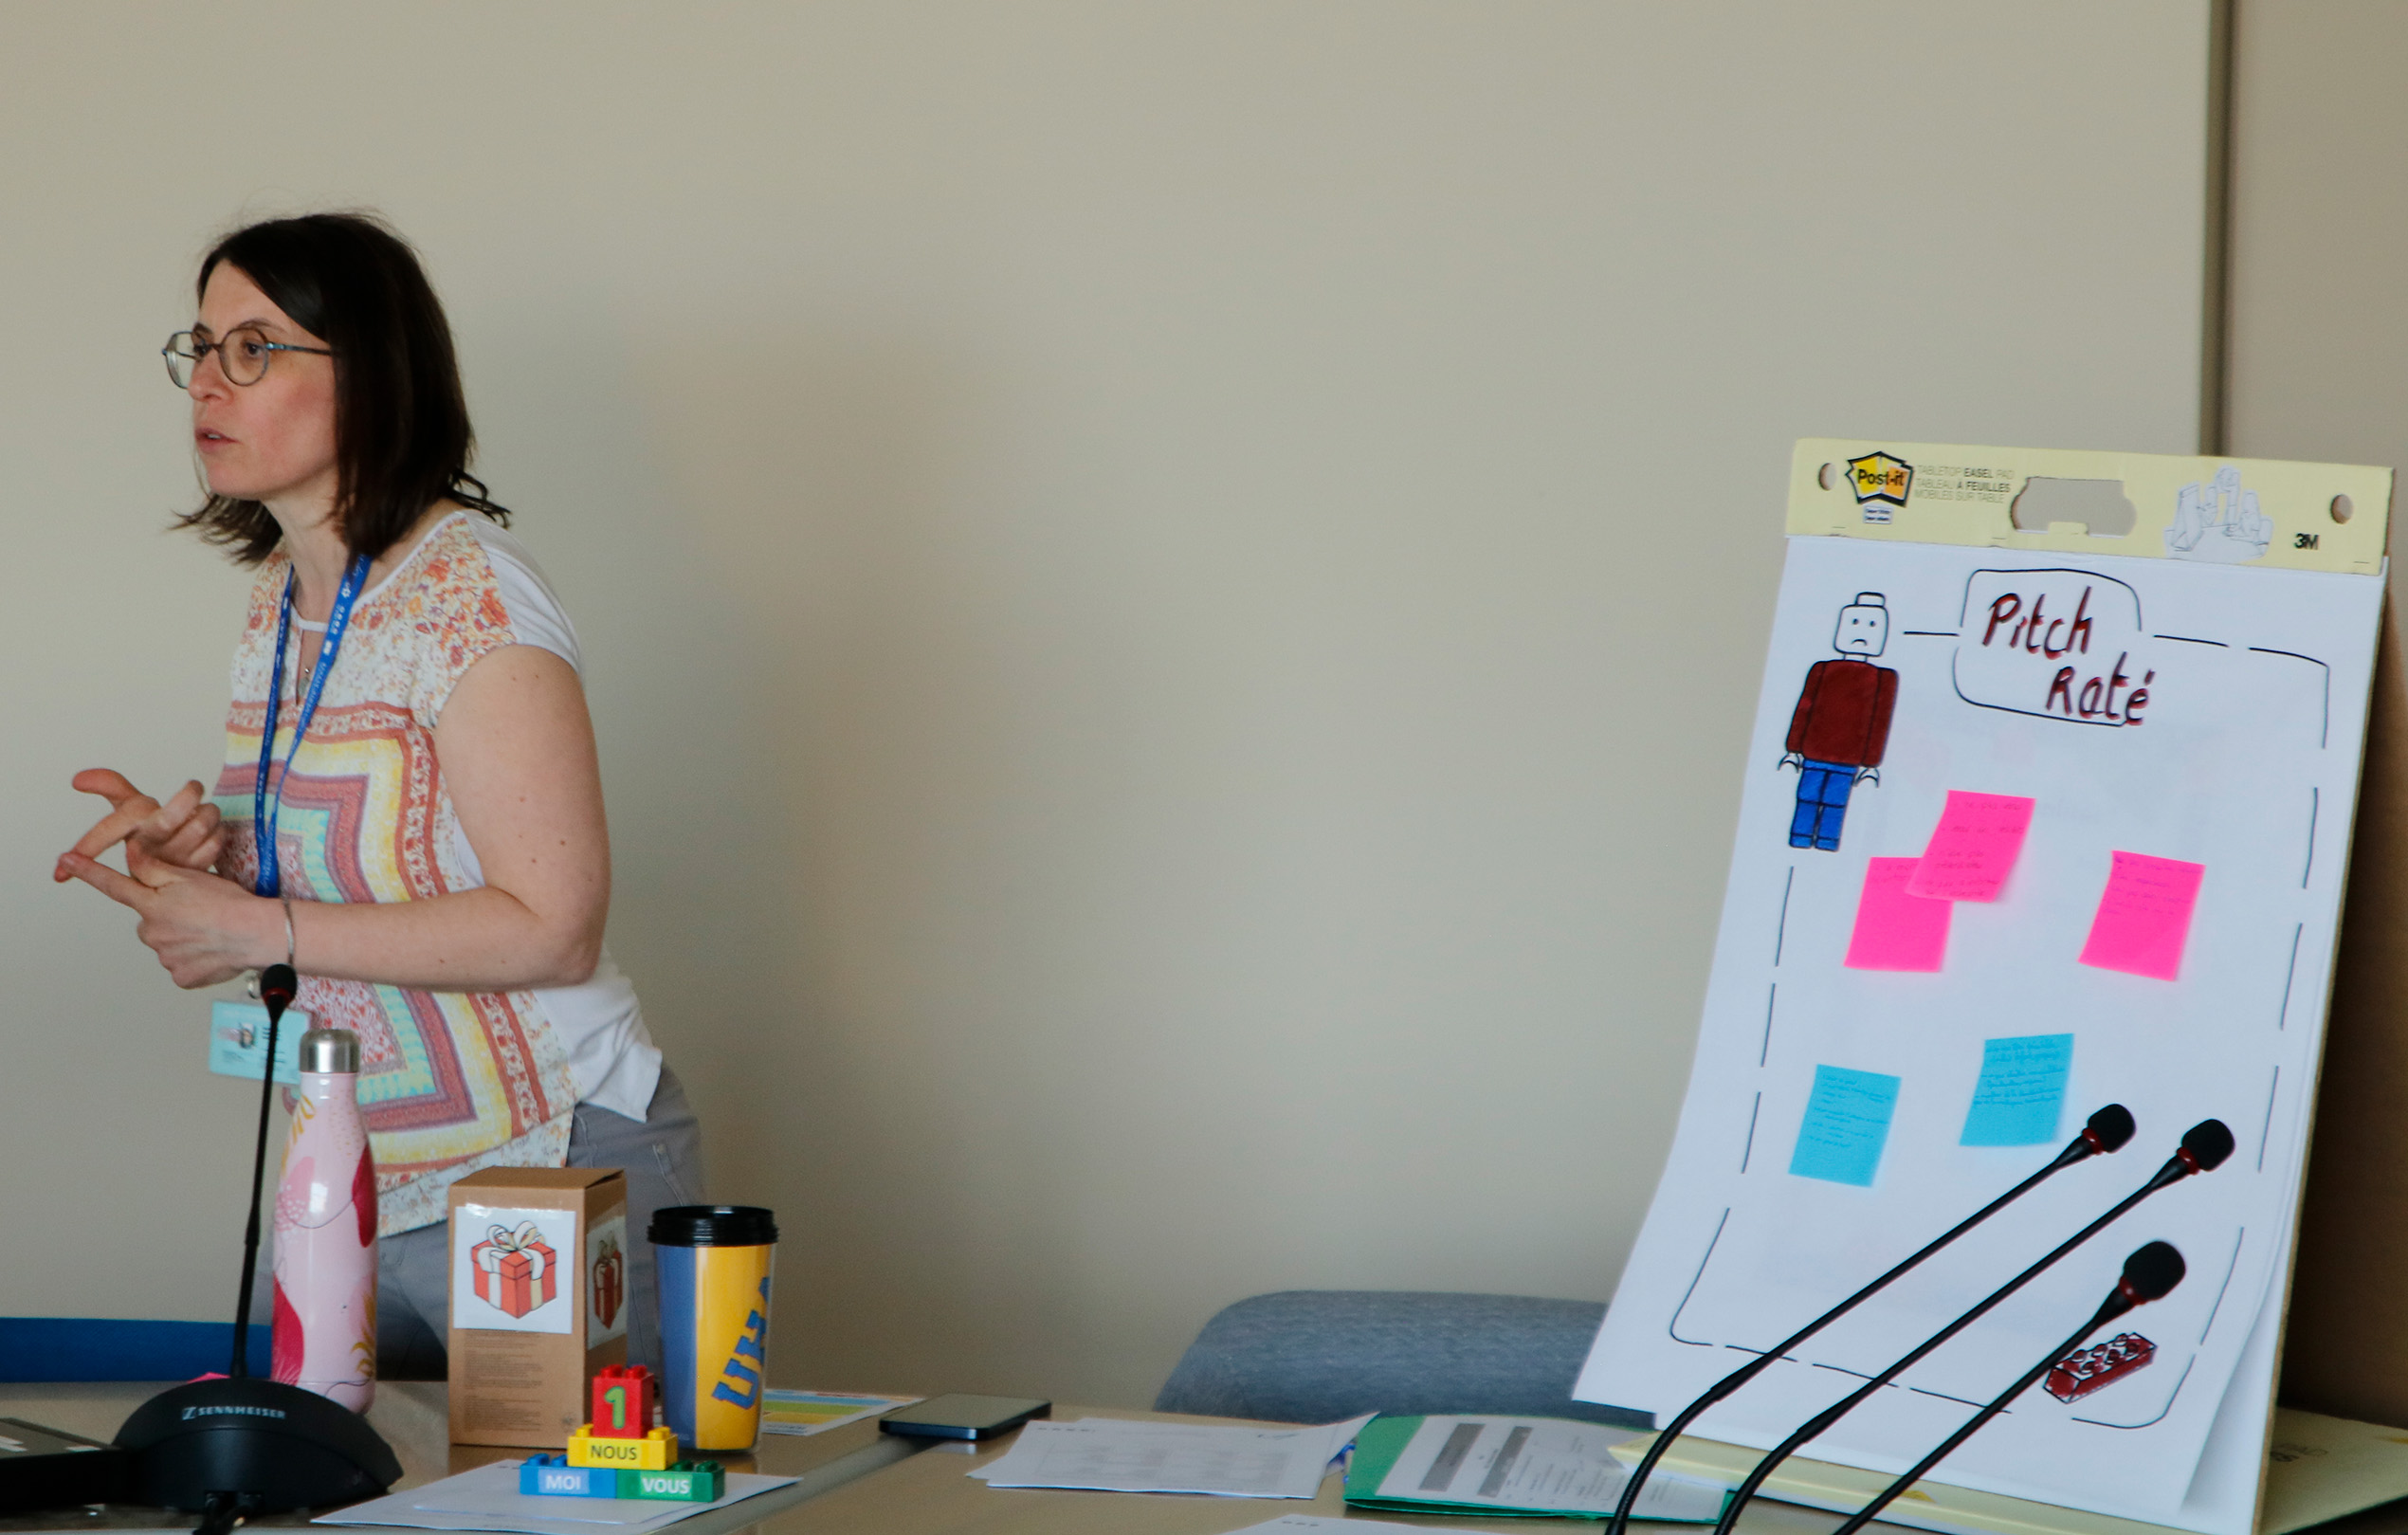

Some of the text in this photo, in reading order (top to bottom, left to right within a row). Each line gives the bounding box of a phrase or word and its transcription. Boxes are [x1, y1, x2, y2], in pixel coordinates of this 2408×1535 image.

[1858, 468, 1905, 486] Post-it
[1964, 467, 1994, 479] EASEL
[1965, 481, 2012, 493] FEUILLES
[2294, 533, 2320, 550] 3M
[1982, 586, 2093, 660] Pitch
[2046, 651, 2156, 726] Raté
[198, 1406, 286, 1420] SENNHEISER
[604, 1385, 626, 1429] 1
[591, 1445, 638, 1461] NOUS
[545, 1474, 581, 1490] MOI
[642, 1478, 691, 1494] VOUS
